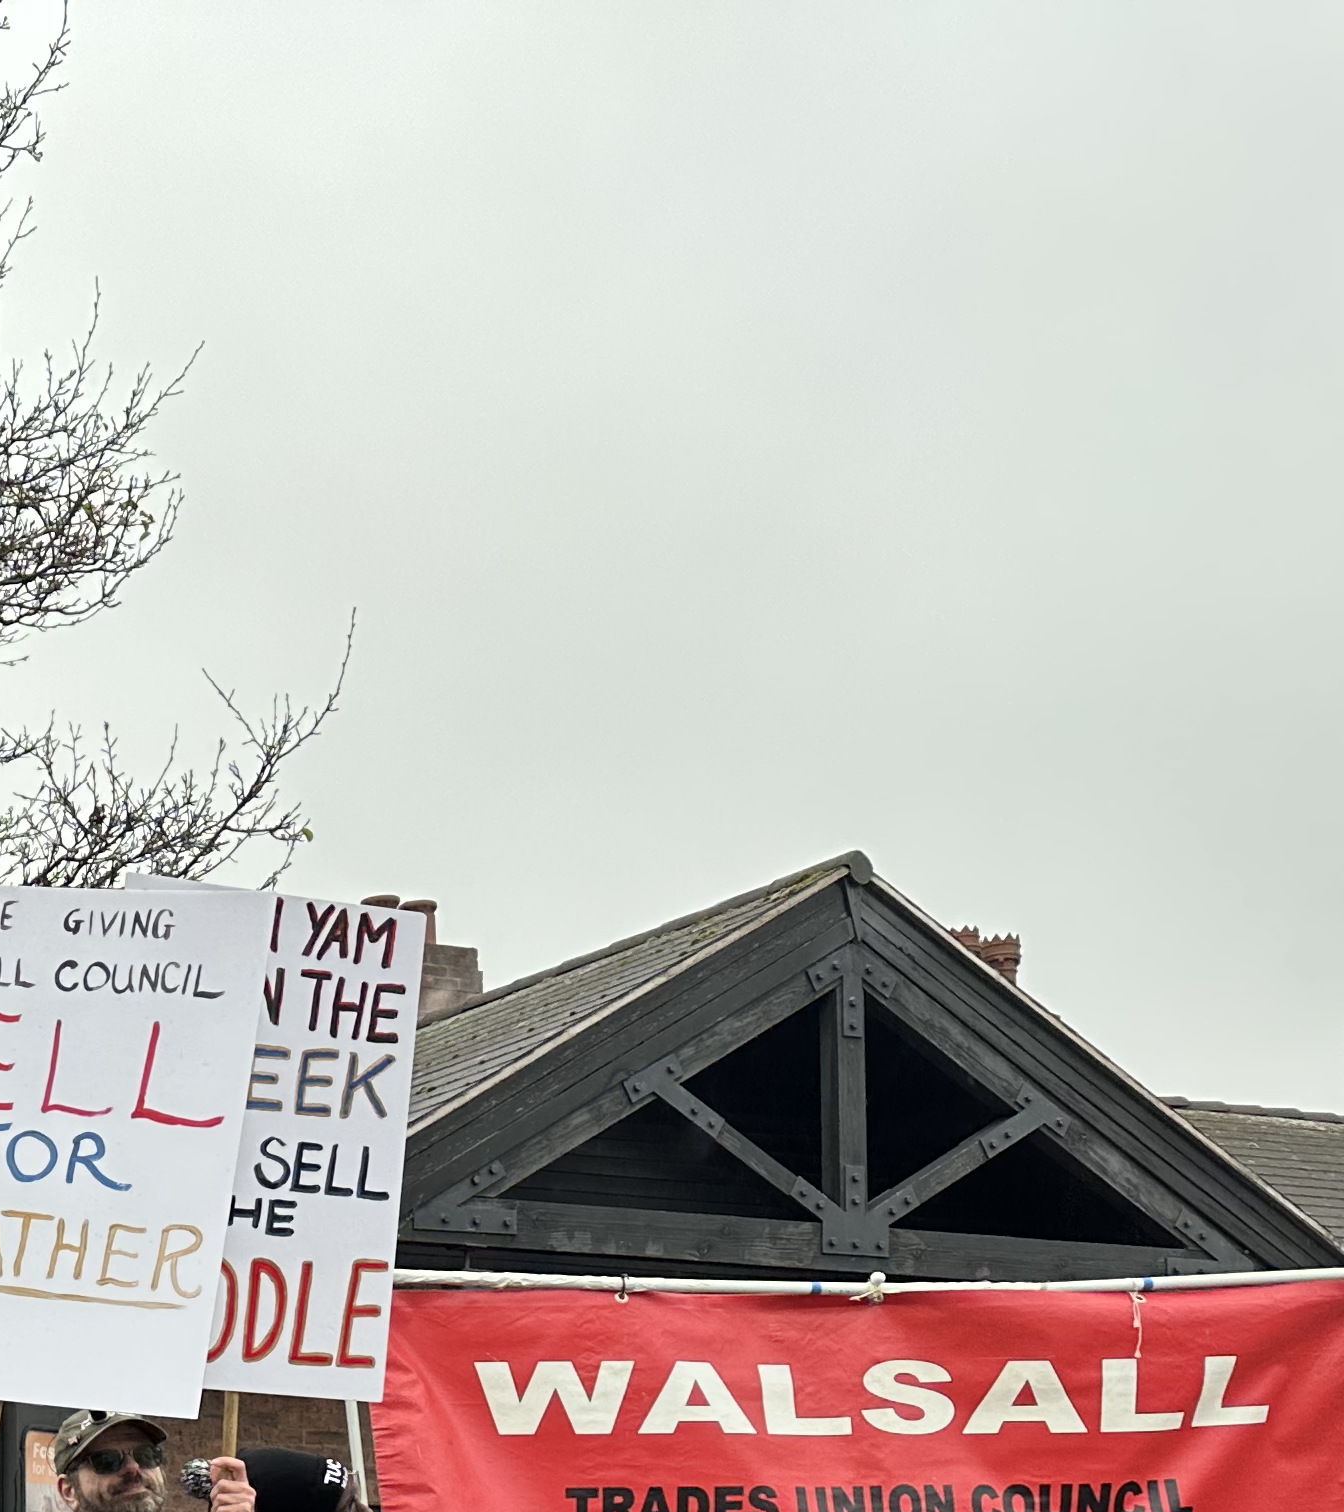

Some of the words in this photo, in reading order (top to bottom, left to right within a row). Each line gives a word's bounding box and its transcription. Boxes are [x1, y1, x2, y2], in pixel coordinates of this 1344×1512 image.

[63, 908, 176, 940] GIVING
[302, 901, 397, 969] YAM
[54, 959, 226, 1000] COUNCIL
[264, 968, 285, 1026] N
[300, 968, 406, 1044] THE
[246, 1044, 396, 1119] EEK
[253, 1136, 390, 1200] SELL
[228, 1195, 298, 1237] HE
[474, 1355, 1269, 1435] WALSALL
